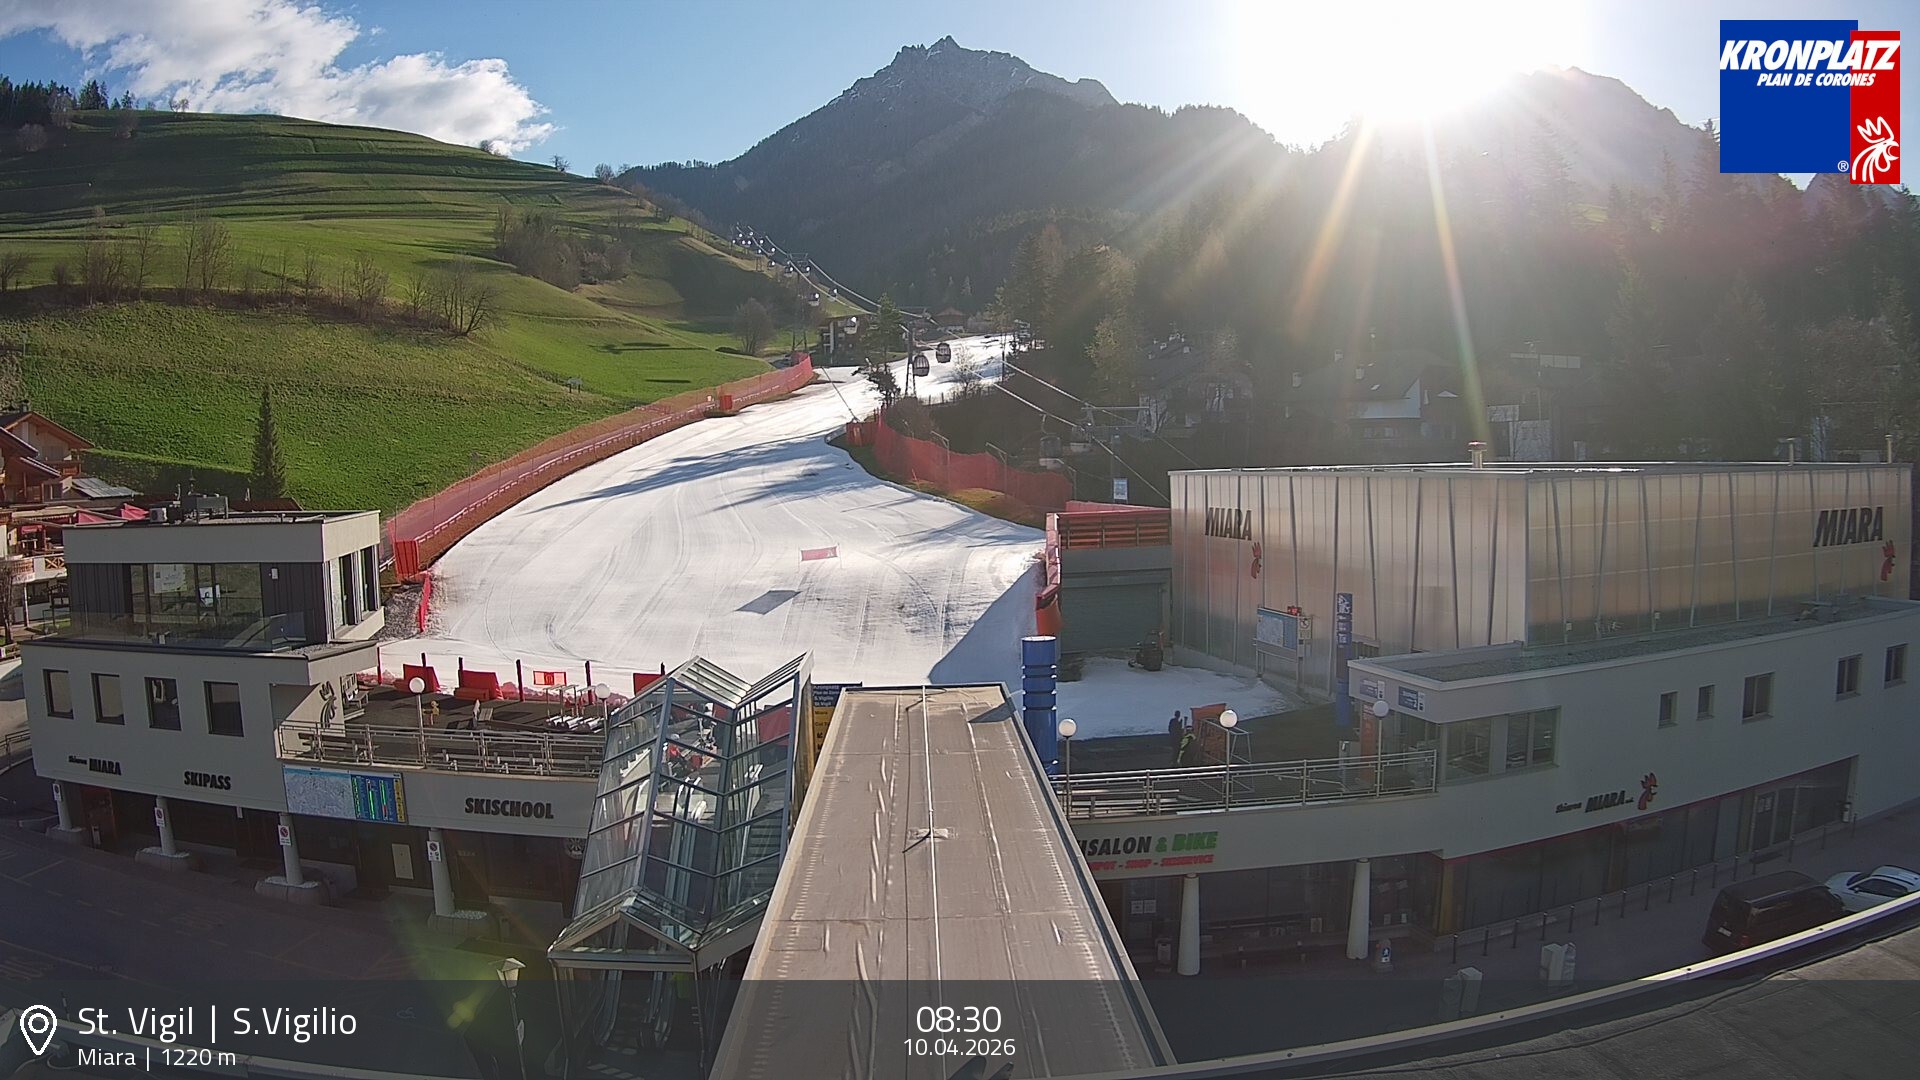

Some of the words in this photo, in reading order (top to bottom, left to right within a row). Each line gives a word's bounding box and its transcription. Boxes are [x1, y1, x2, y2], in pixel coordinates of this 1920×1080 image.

[1204, 507, 1251, 541] MIARA
[1813, 506, 1883, 547] MIARA
[89, 758, 122, 776] MIARA
[184, 771, 232, 791] SKIPASS
[464, 797, 555, 819] SKISCHOOL
[1585, 790, 1625, 813] MIARA
[1155, 837, 1168, 852] &
[1173, 831, 1218, 850] BIKE
